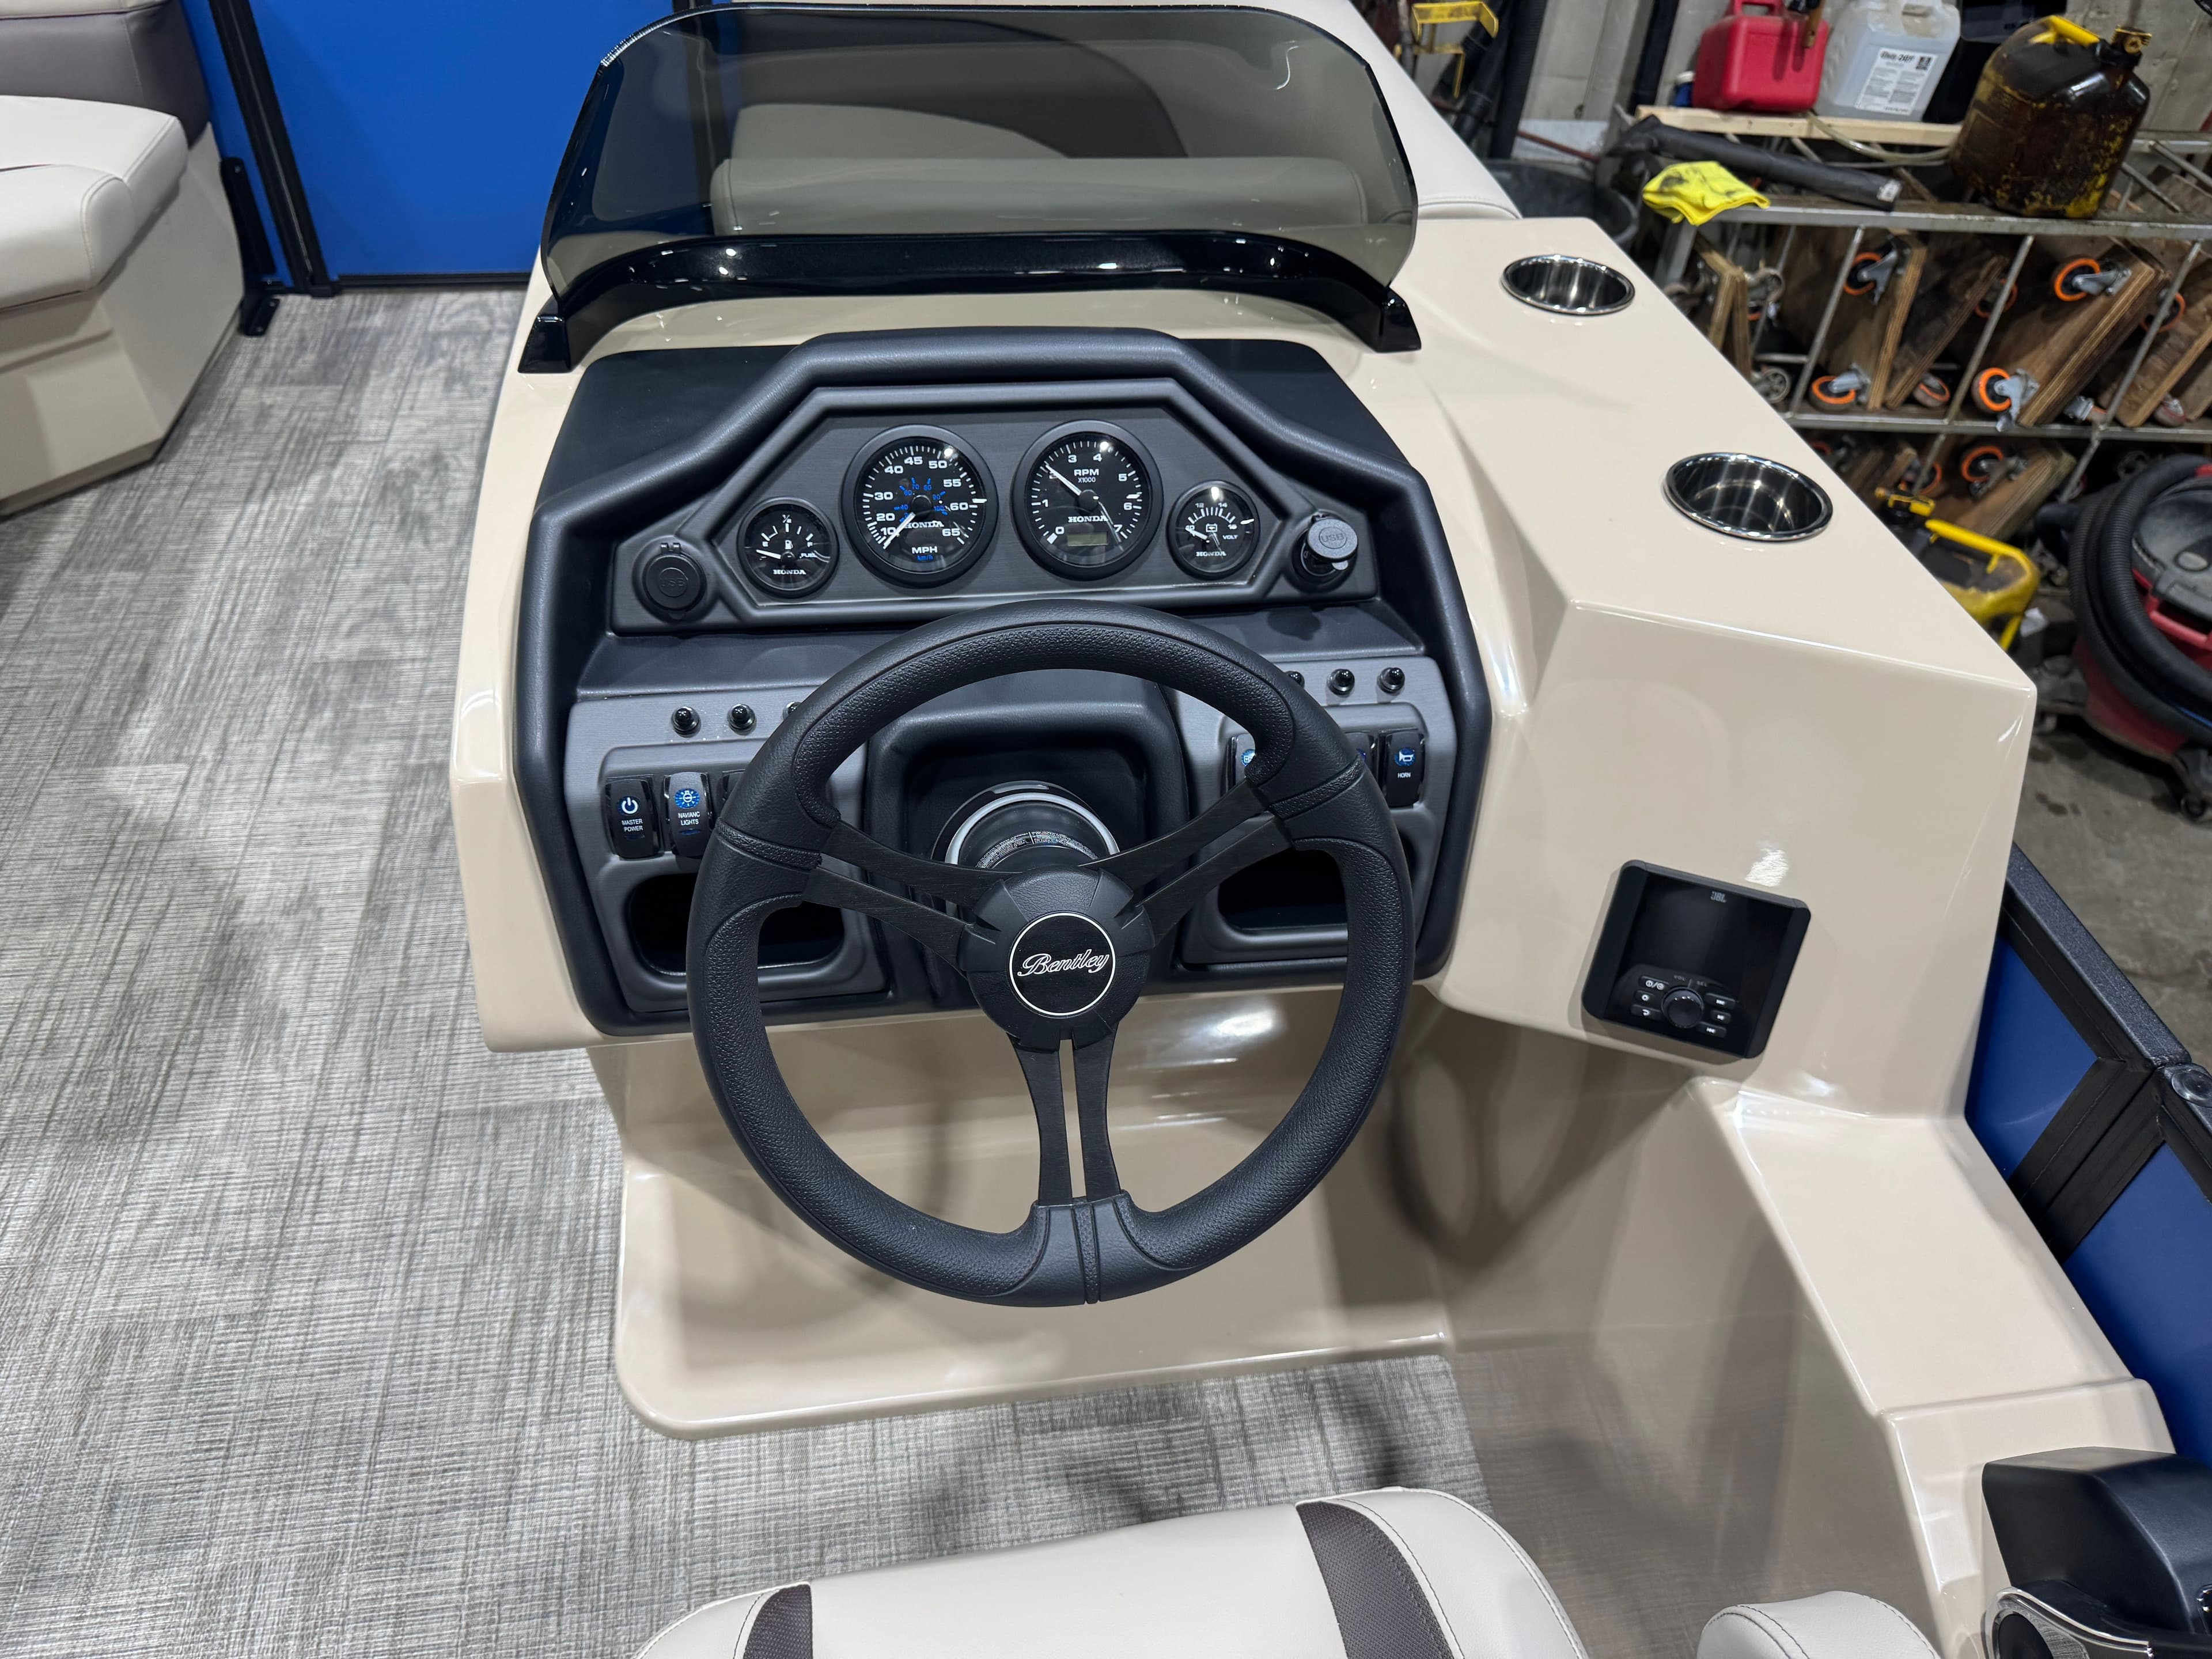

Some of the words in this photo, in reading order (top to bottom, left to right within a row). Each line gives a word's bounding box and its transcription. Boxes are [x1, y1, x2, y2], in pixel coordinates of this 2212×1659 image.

[904, 456, 923, 465] 45
[1068, 454, 1077, 463] 3
[1093, 453, 1103, 462] 4
[929, 460, 948, 469] 50
[884, 465, 903, 474] 40
[1118, 474, 1127, 482] 5
[943, 479, 961, 487] 55
[874, 491, 893, 501] 30
[950, 502, 968, 511] 60
[1123, 502, 1132, 510] 6
[876, 513, 895, 521] 20
[880, 527, 897, 536] 10
[942, 528, 960, 536] 65
[1055, 527, 1065, 535] 0
[1113, 524, 1123, 533] 7
[1321, 532, 1344, 543] USB
[1017, 949, 1110, 976] Bentley
